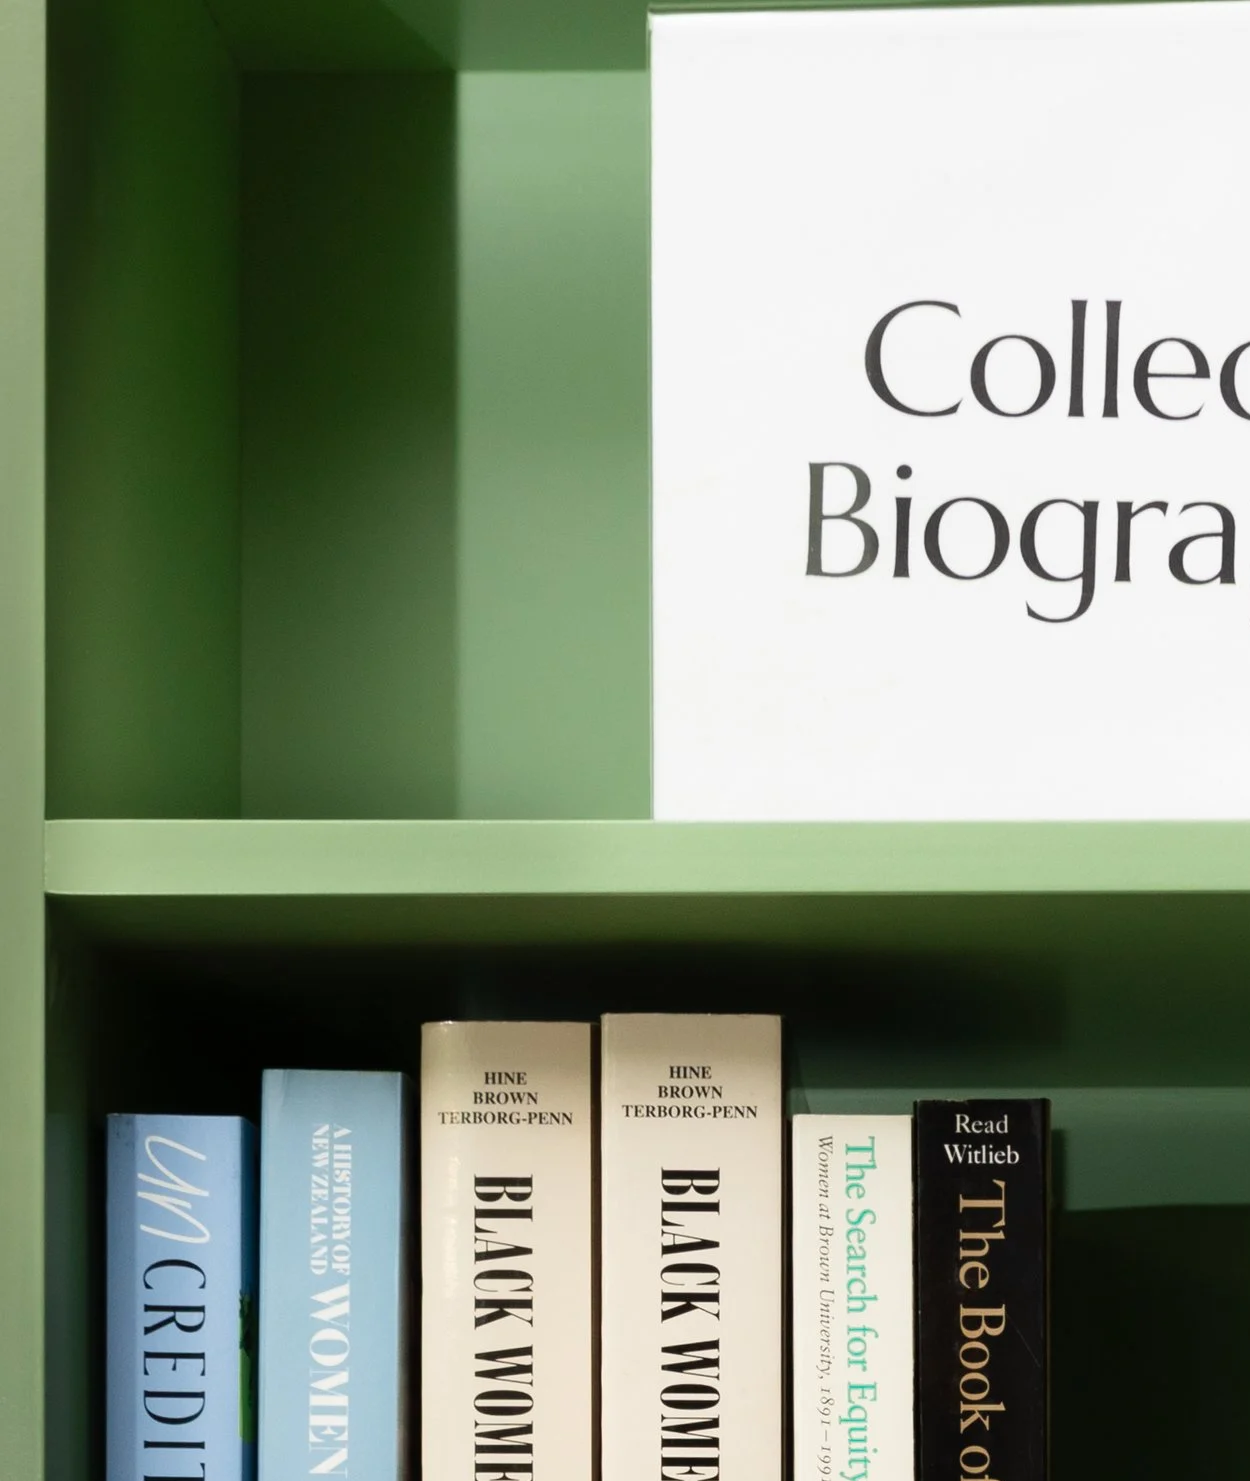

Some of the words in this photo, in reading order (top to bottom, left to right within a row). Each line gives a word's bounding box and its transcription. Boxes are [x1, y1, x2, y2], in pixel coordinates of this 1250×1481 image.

[473, 1091, 539, 1105] BROWN
[484, 1071, 527, 1086] HINE
[311, 1123, 331, 1170] NEW
[330, 1122, 353, 1139] A
[438, 1111, 574, 1126] TERBORG-PENN
[954, 1114, 1009, 1135] Read
[818, 1134, 834, 1200] Women
[844, 1135, 878, 1200] The
[943, 1144, 1020, 1165] Witlieb
[330, 1144, 353, 1241] HISTORY
[819, 1204, 831, 1219] at
[310, 1174, 331, 1276] ZEALAND
[473, 1173, 535, 1329] BLACK
[819, 1221, 834, 1283] Brown
[958, 1179, 1006, 1290] The
[330, 1243, 352, 1275] OF
[846, 1209, 878, 1314] Search
[817, 1289, 836, 1380] University,
[847, 1323, 879, 1373] for
[308, 1282, 351, 1478] WOMEN
[958, 1304, 1007, 1435] Book
